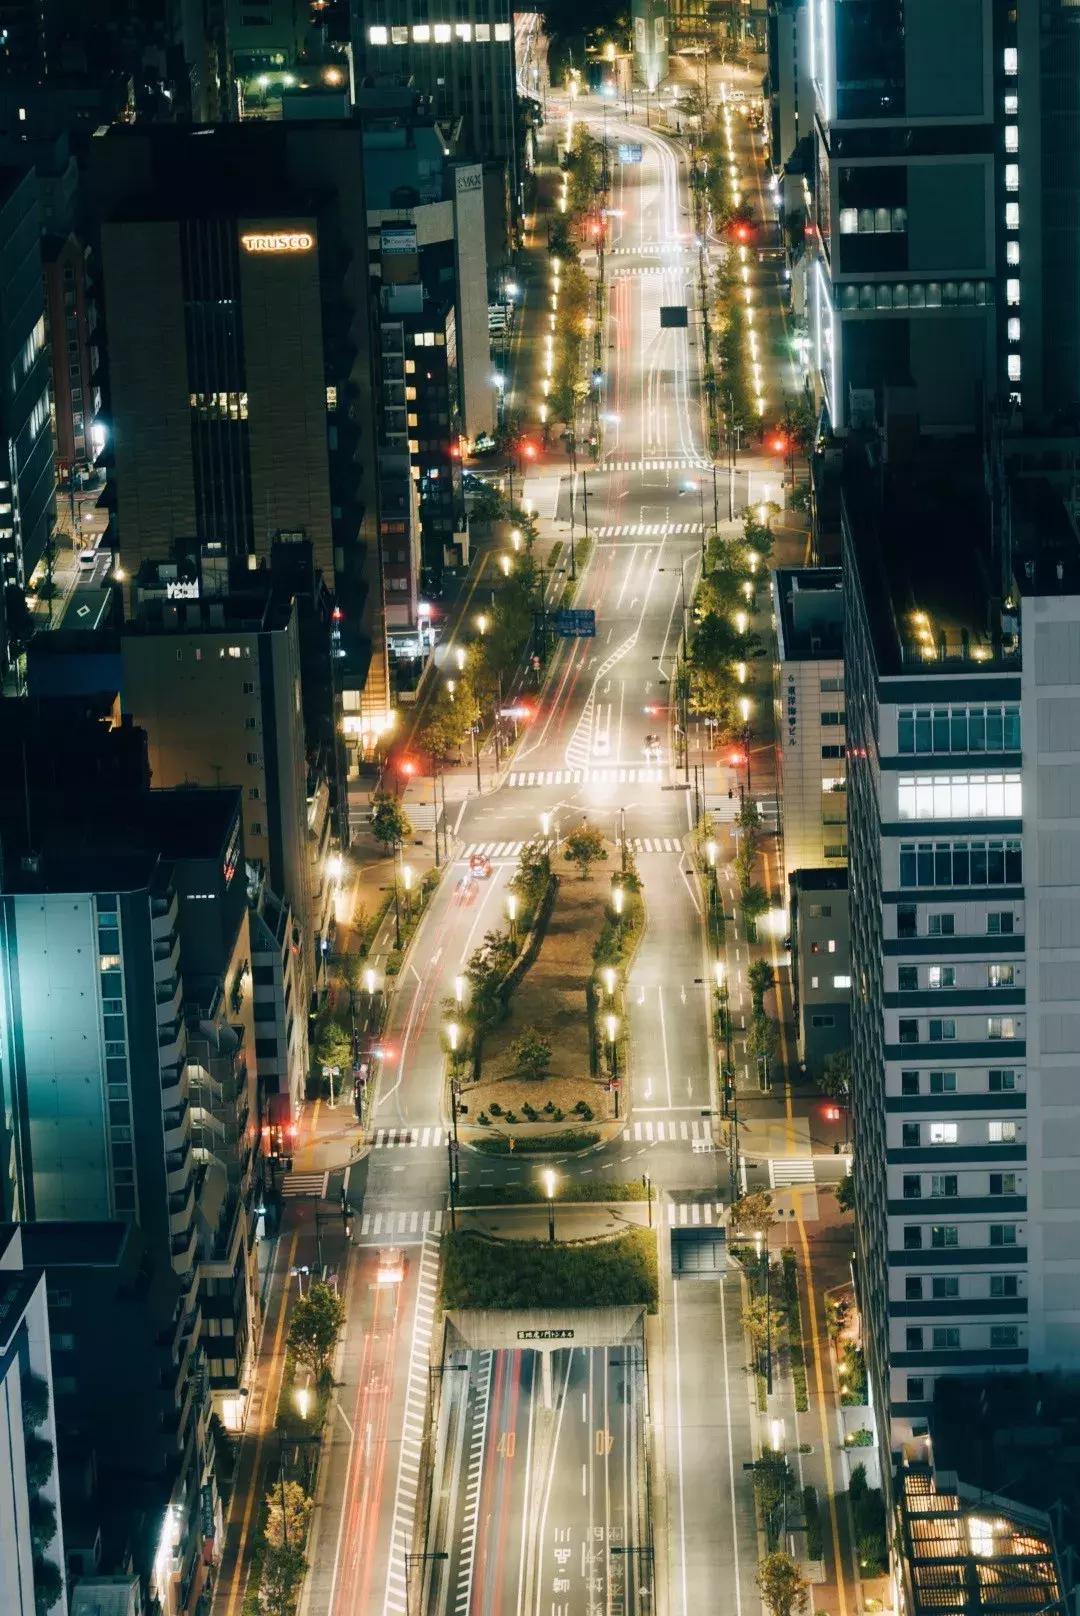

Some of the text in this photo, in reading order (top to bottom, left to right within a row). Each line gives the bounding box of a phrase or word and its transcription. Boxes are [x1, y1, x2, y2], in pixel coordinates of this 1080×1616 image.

[244, 236, 311, 250] TRUSCO
[496, 1431, 516, 1457] 40
[595, 1429, 615, 1456] 40
